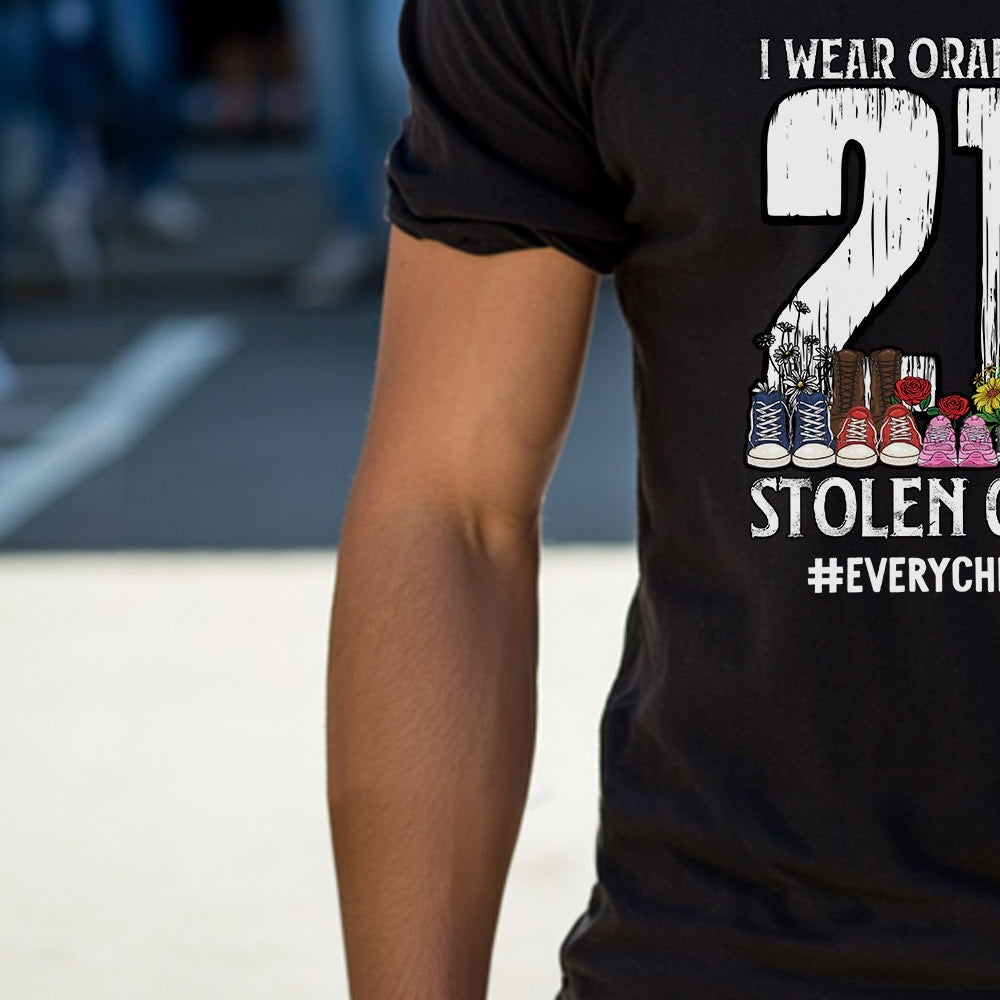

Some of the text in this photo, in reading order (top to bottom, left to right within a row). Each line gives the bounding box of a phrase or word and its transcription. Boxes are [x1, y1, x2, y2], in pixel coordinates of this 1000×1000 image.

[759, 38, 771, 80] I
[784, 37, 896, 80] WEAR
[750, 476, 968, 539] STOLEN
